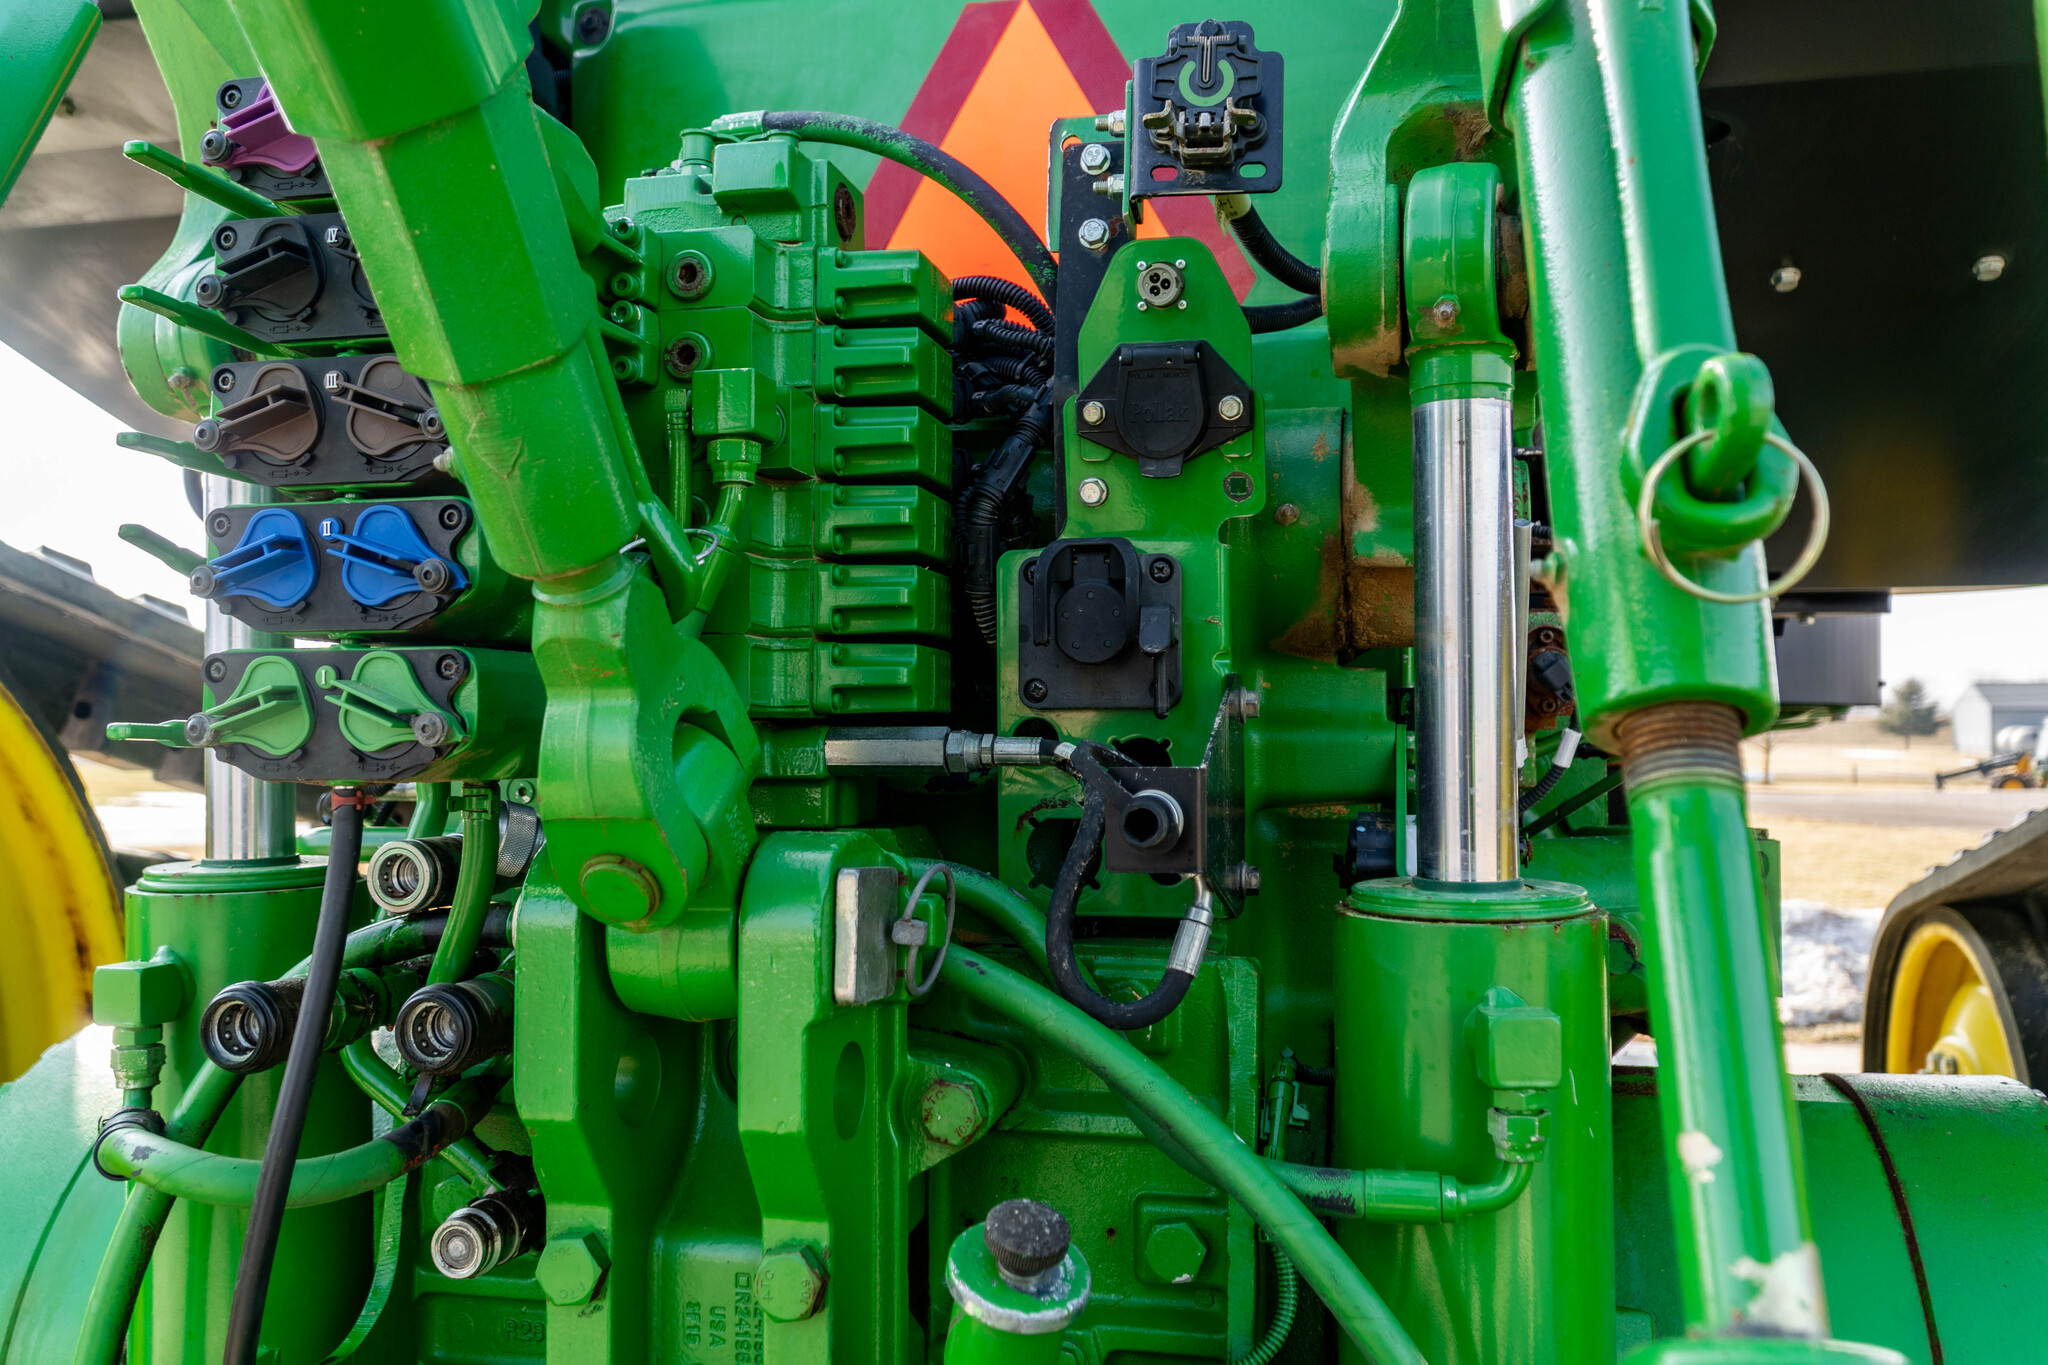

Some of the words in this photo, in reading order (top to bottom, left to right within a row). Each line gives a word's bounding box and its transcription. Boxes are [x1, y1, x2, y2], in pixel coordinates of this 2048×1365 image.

[327, 228, 338, 243] IV
[325, 373, 338, 389] III
[1130, 400, 1189, 423] Pollak
[322, 521, 331, 536] II
[320, 670, 326, 684] I
[709, 1306, 727, 1348] USA
